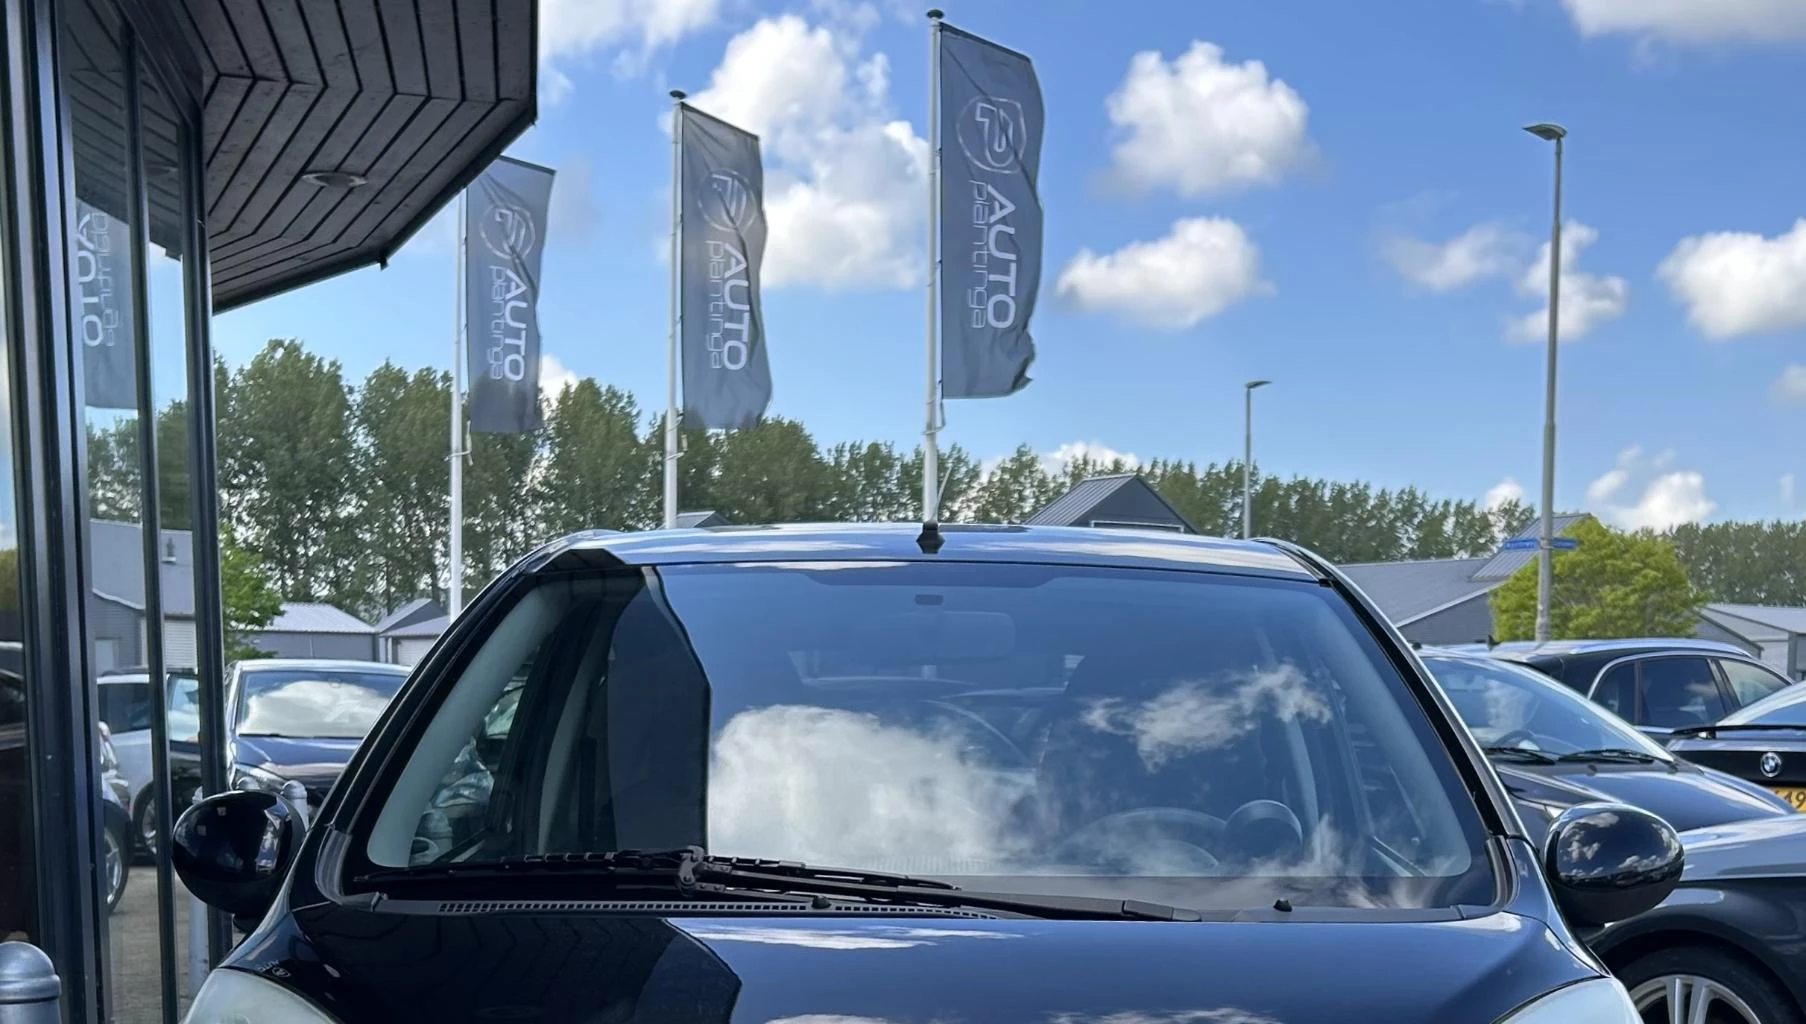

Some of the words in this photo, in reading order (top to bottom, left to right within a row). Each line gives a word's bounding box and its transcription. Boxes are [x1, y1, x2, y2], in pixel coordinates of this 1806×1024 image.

[705, 239, 727, 369] plantinga
[723, 242, 750, 371] AUTO
[968, 179, 990, 329] plantinga
[987, 183, 1017, 329] AUTO
[486, 264, 506, 380] plantinga
[504, 268, 529, 381] AUTO
